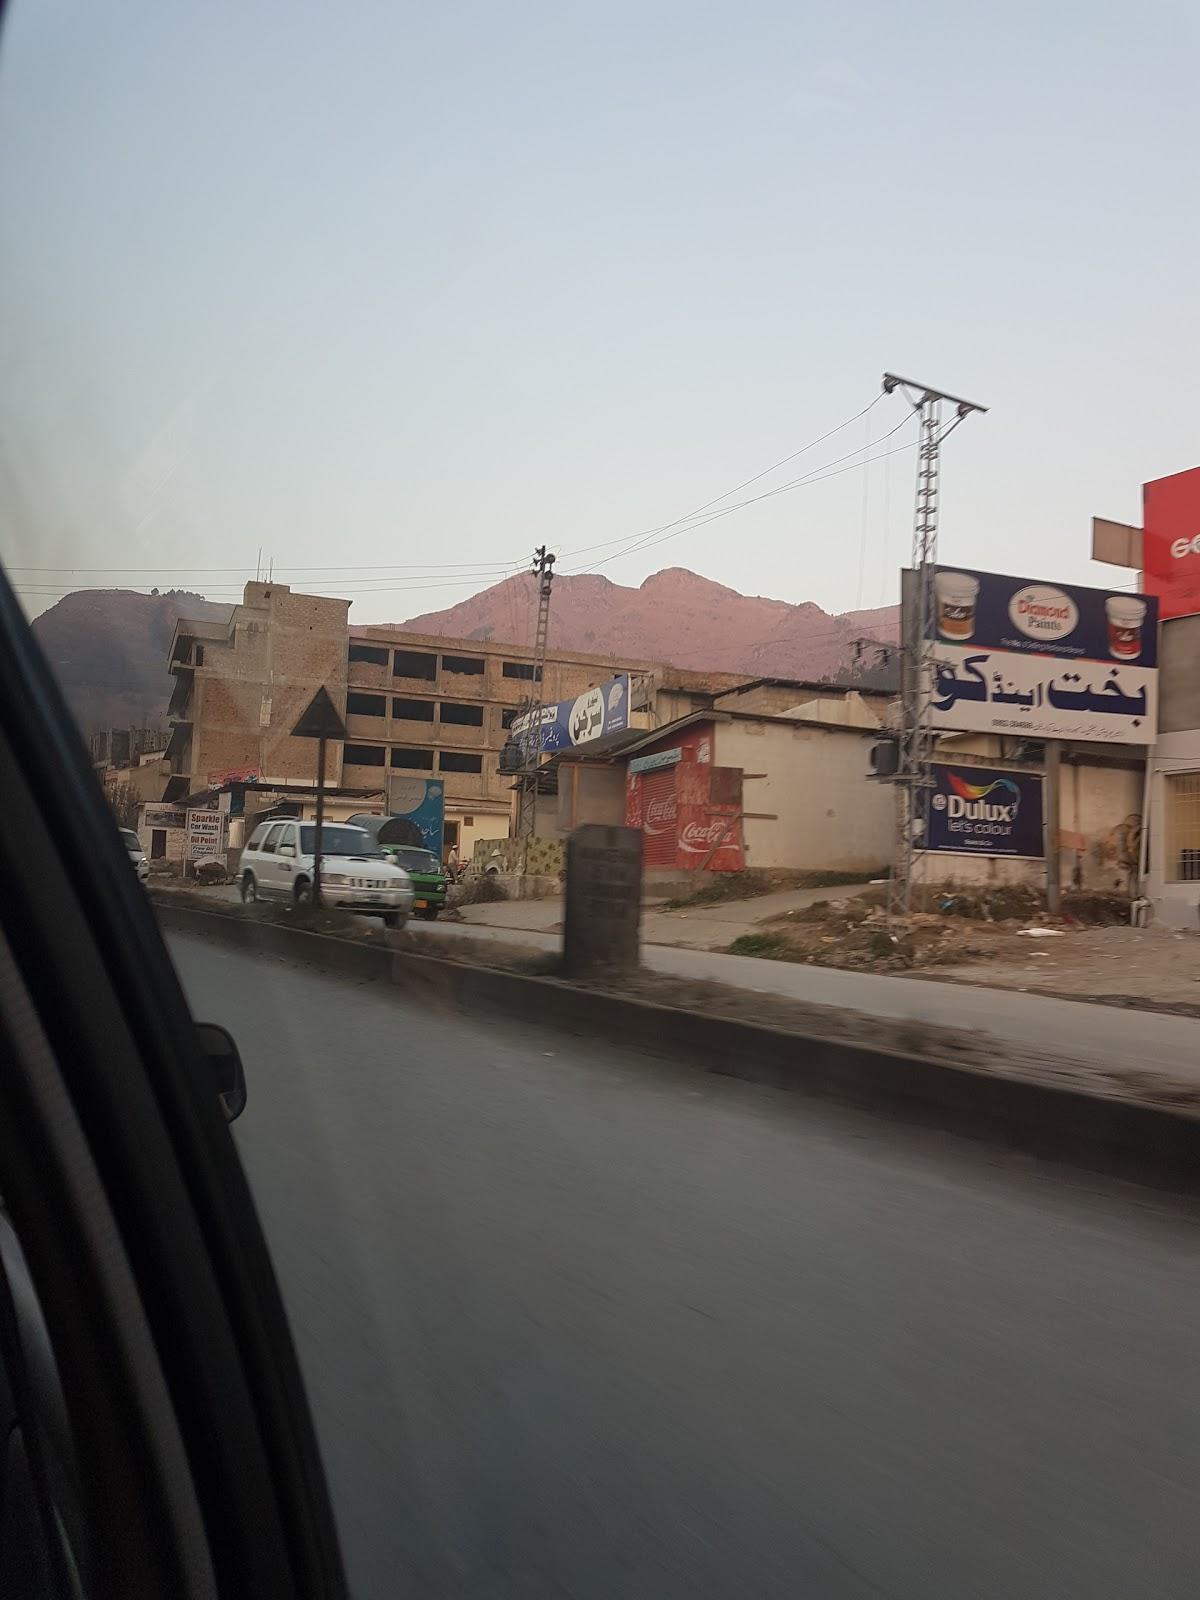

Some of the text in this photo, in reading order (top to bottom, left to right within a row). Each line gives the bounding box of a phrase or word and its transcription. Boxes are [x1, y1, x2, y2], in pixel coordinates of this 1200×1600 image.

[1017, 599, 1069, 619] Diamond
[947, 795, 1013, 822] Dulux
[191, 814, 220, 823] Sparkle
[974, 820, 1013, 836] colour
[191, 836, 200, 844] Oil
